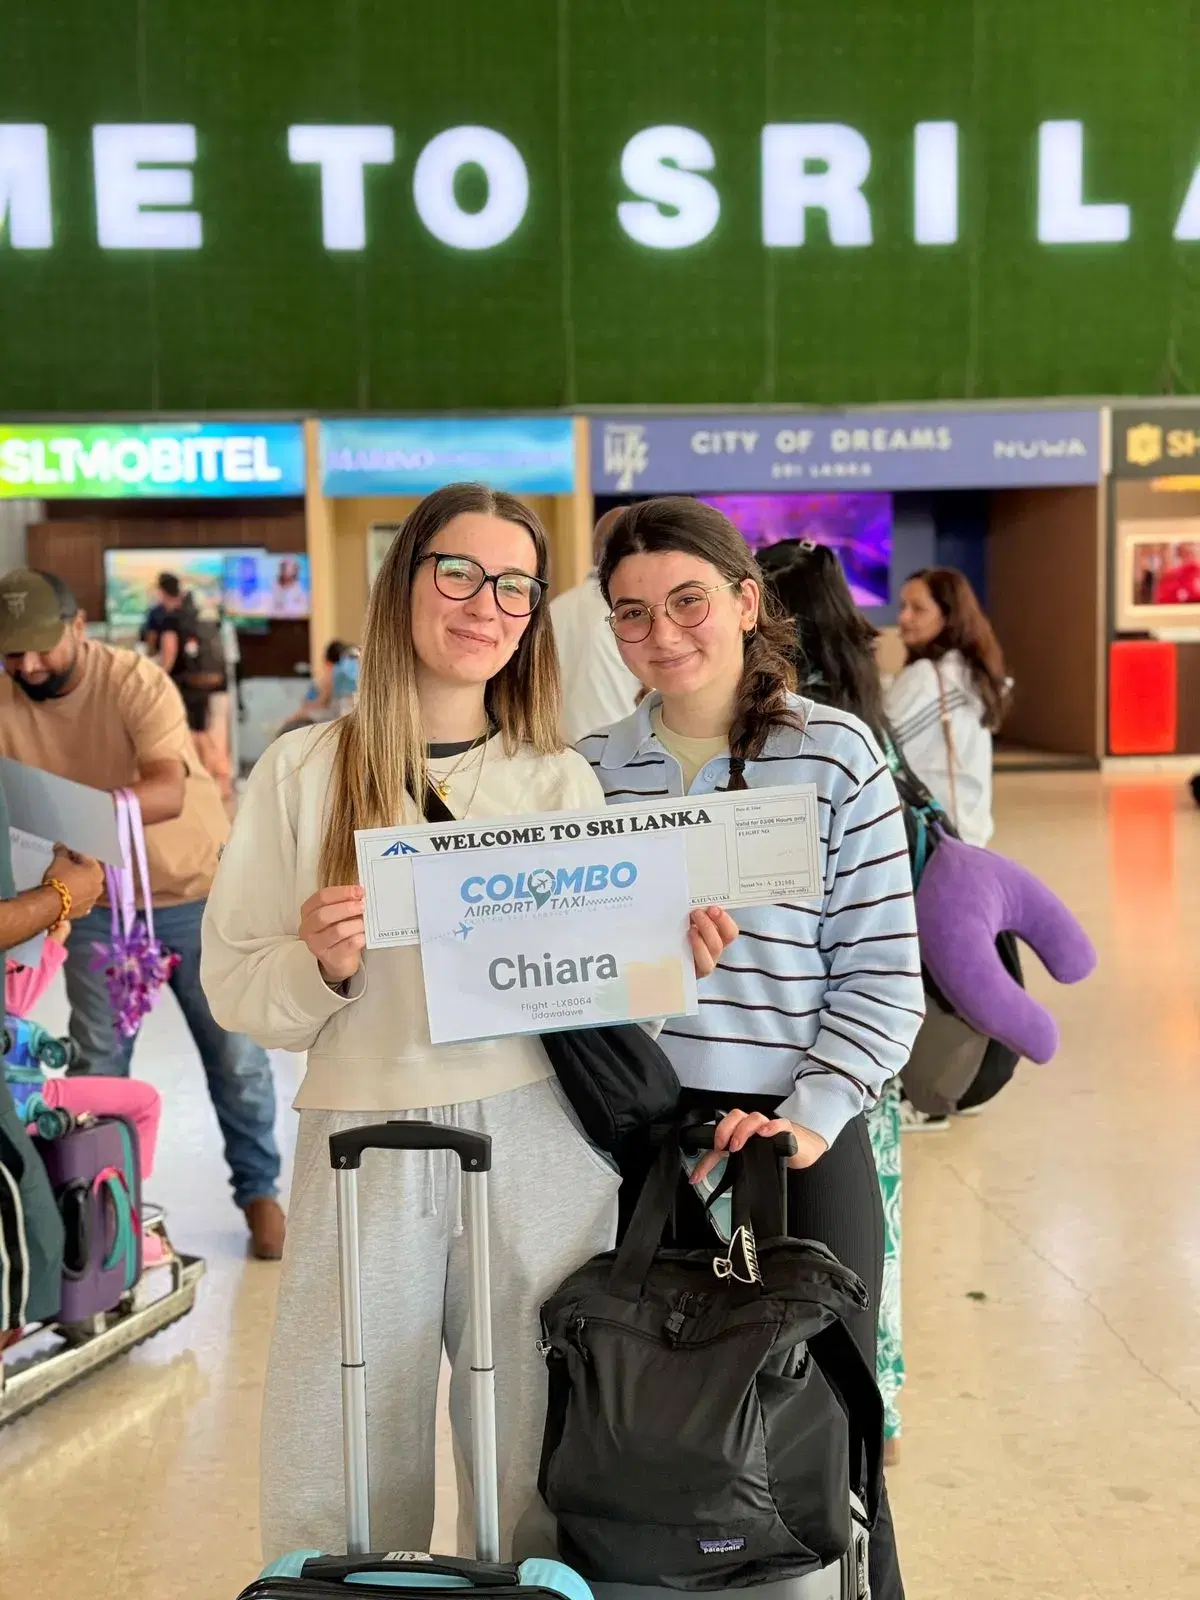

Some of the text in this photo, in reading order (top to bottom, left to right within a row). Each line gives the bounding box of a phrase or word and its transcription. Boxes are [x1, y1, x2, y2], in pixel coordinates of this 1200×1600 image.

[287, 124, 530, 251] TO
[616, 120, 958, 249] SRI
[1037, 119, 1200, 243] L
[691, 426, 952, 455] CITY OF DREAMS
[993, 438, 1087, 460] NUWA
[0, 436, 282, 484] SLTMOBITEL
[430, 809, 712, 852] WELCOME TO SRI LANKA
[460, 861, 638, 903] COLOMBO
[464, 901, 533, 918] AIRPORT
[551, 895, 586, 910] TAXI
[488, 952, 618, 991] Chiara
[521, 1001, 548, 1012] Flight
[531, 1008, 584, 1020] Udawalawe
